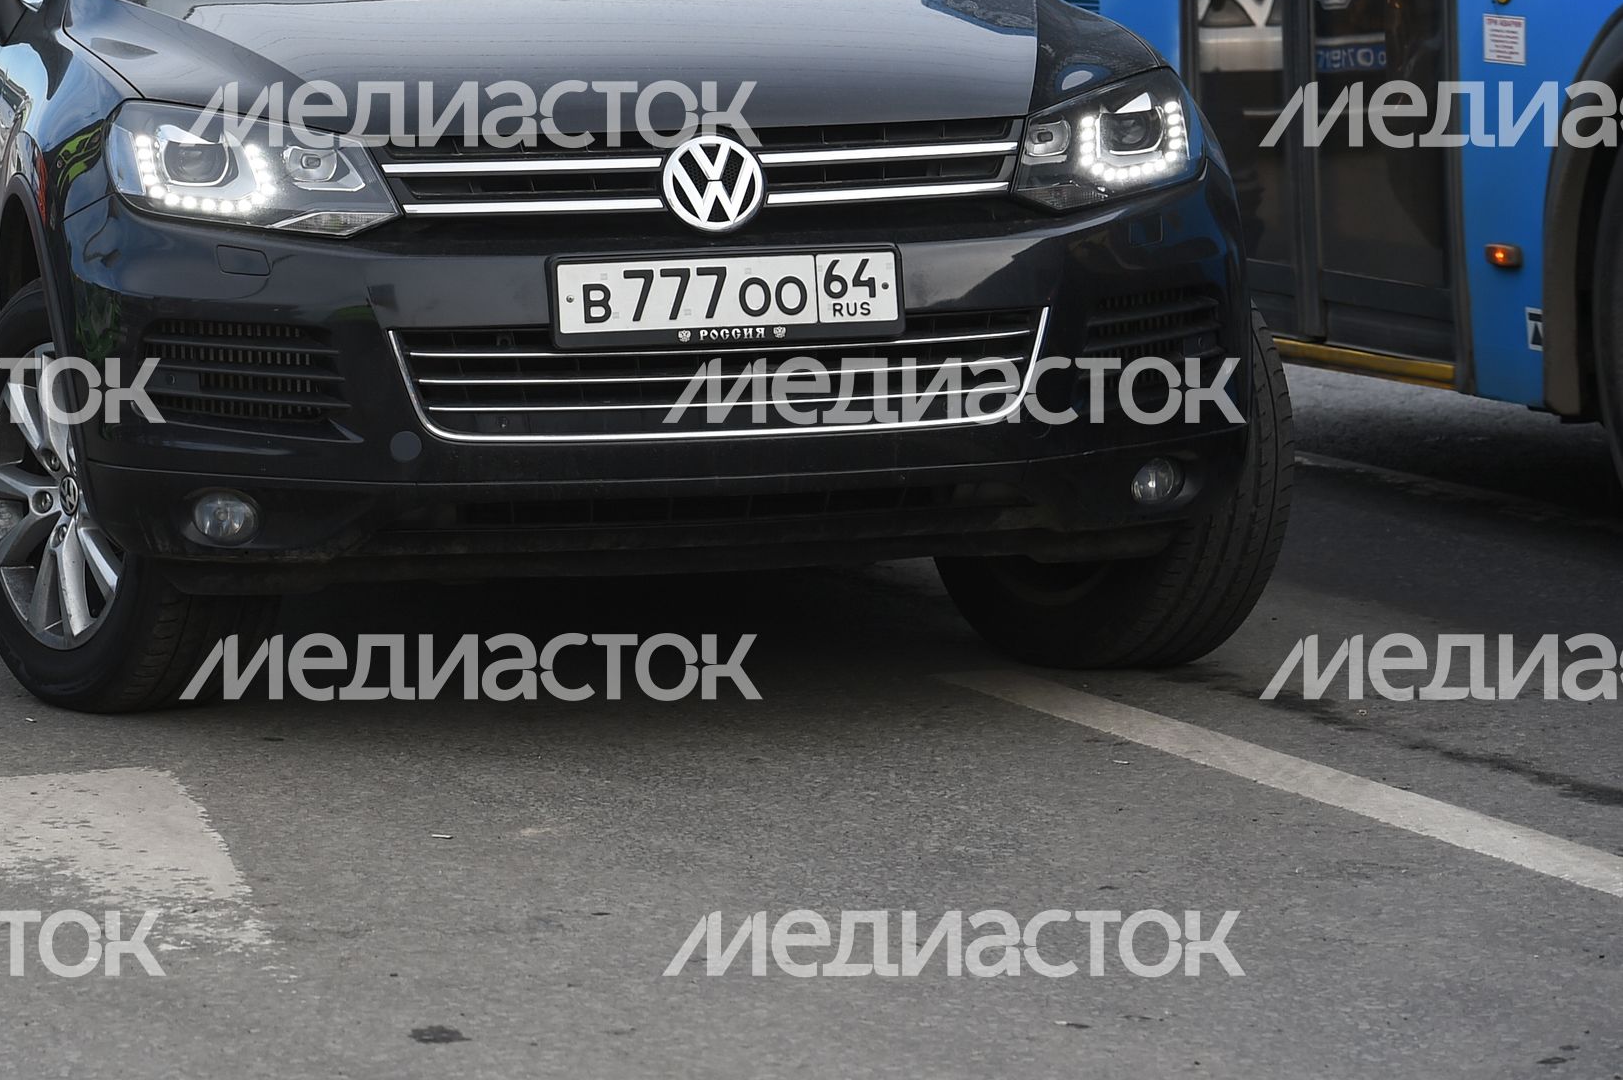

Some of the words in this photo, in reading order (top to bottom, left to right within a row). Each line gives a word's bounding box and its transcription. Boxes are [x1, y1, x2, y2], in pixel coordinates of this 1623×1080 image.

[663, 134, 762, 232] VW
[823, 258, 877, 300] 64
[832, 302, 872, 318] RUS
[699, 327, 767, 341] РОССИЯ
